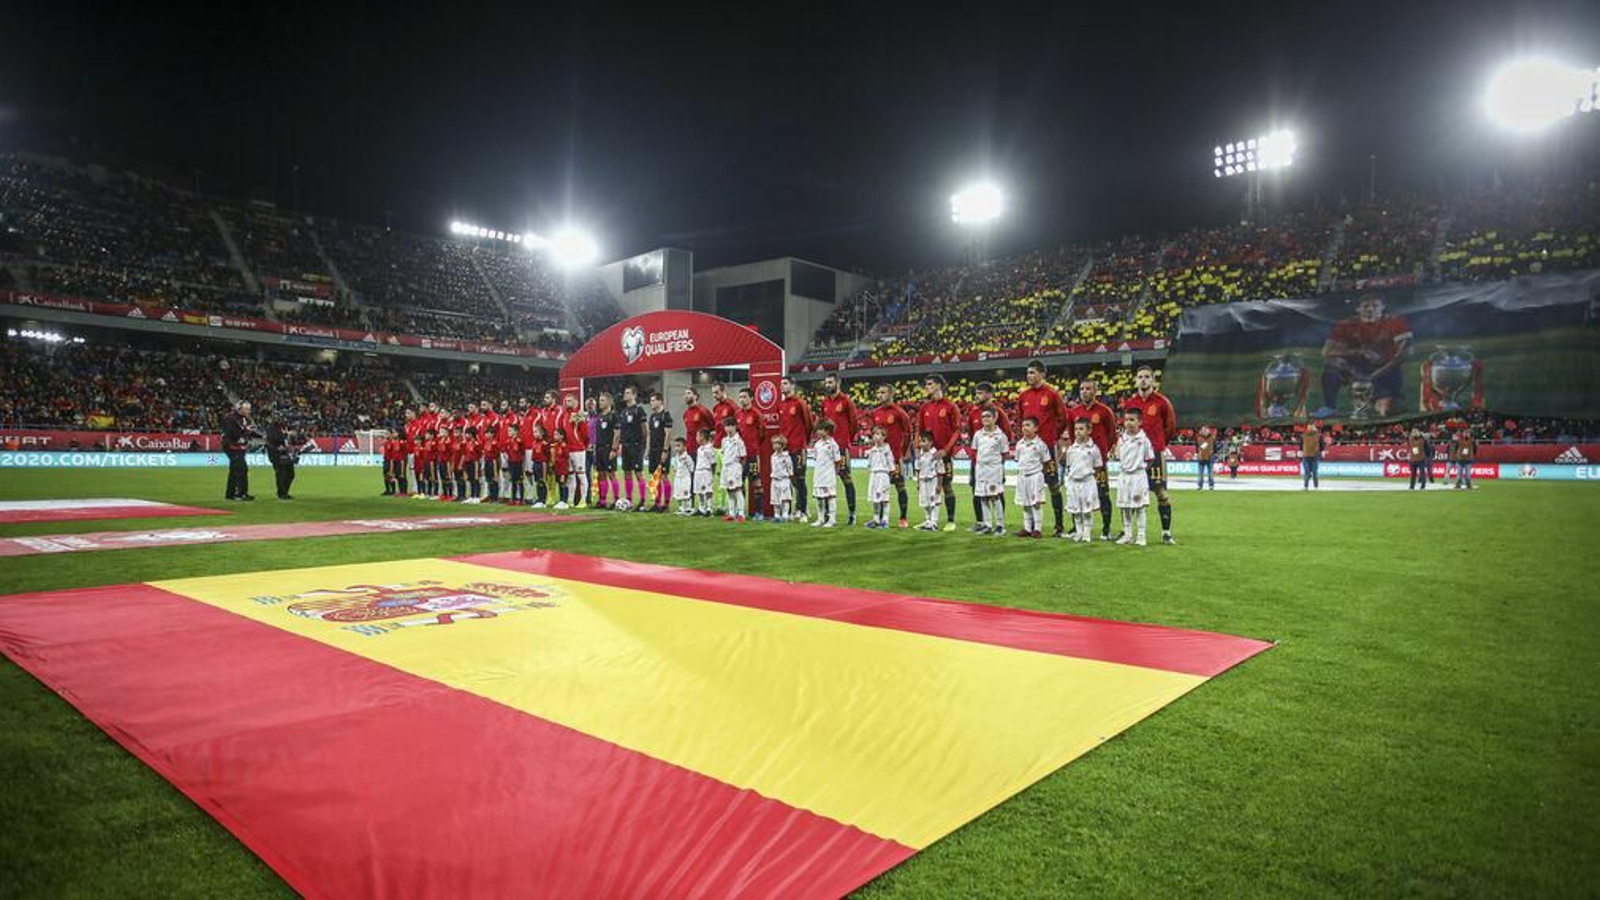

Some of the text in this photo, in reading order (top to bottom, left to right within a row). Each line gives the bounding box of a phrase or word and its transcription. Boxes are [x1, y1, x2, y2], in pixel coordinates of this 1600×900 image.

[650, 329, 689, 343] EUROPEAN
[645, 339, 695, 357] QUALIFIERS
[2, 453, 178, 467] 2020.COM/TICKETS
